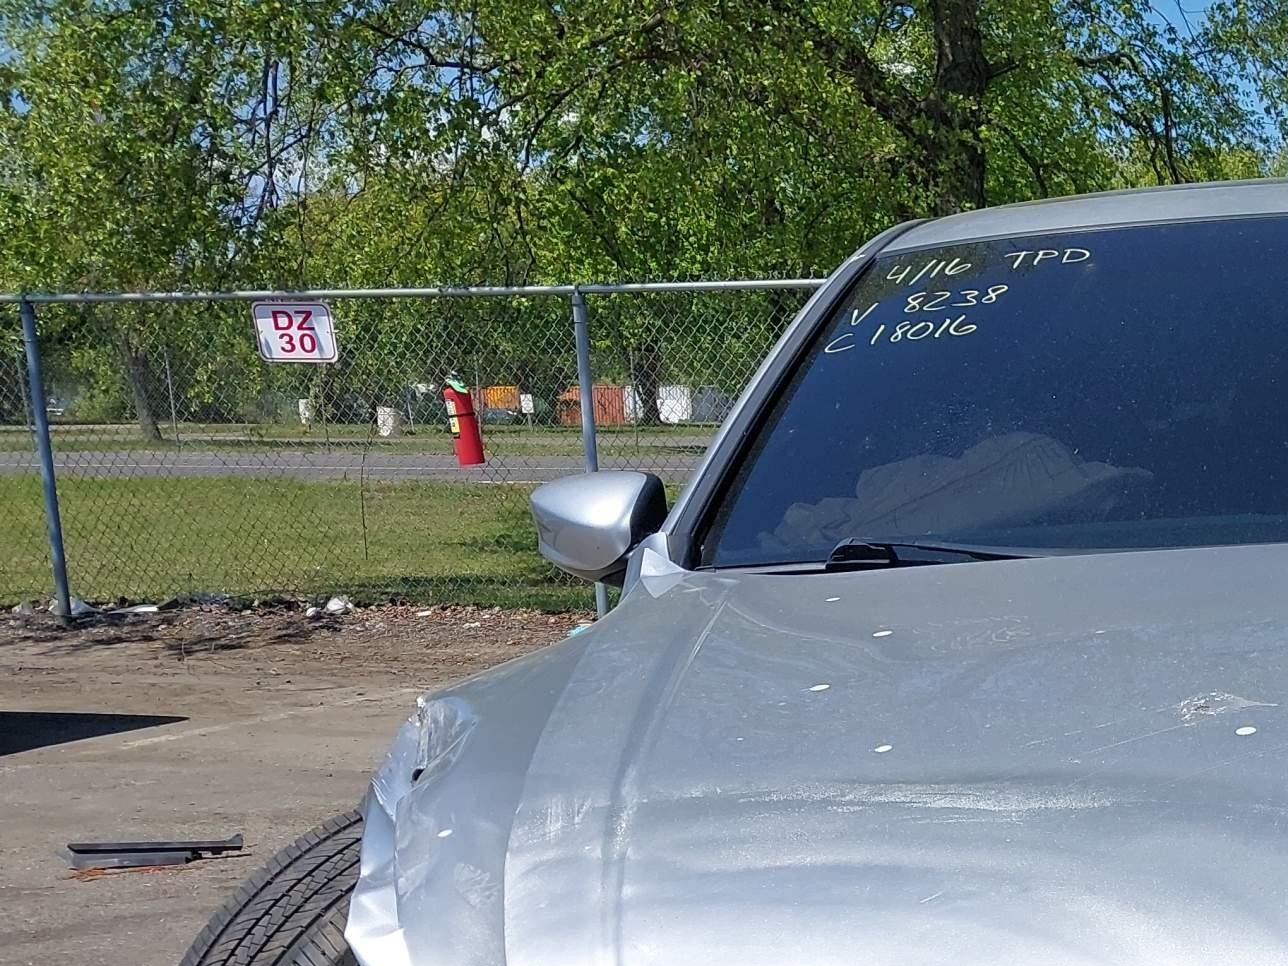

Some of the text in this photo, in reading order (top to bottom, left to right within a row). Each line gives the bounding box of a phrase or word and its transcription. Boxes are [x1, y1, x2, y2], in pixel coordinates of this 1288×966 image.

[886, 248, 1091, 286] 4/16 TPD
[271, 310, 315, 331] DZ
[850, 284, 1009, 326] V 8238
[280, 333, 317, 353] 30
[824, 315, 978, 354] C 18016
